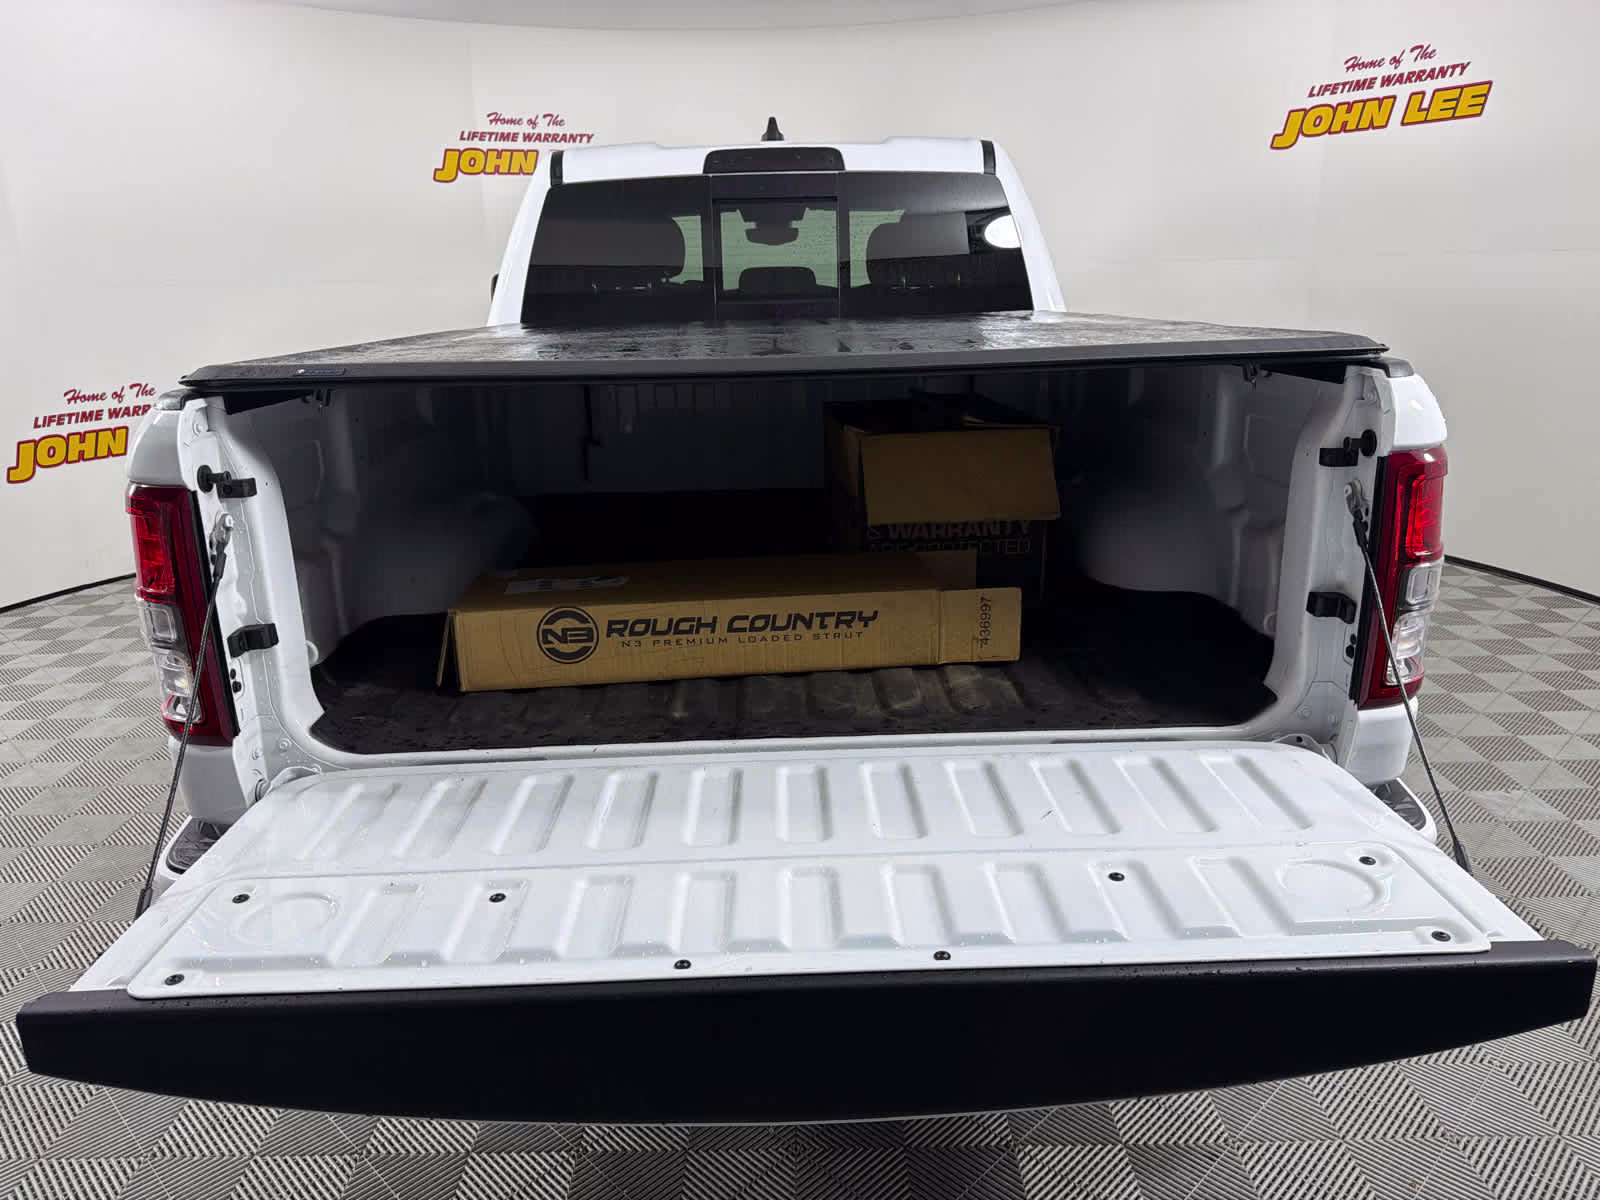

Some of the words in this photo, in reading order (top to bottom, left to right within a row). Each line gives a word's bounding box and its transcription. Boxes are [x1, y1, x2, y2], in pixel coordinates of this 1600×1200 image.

[1344, 55, 1385, 72] Home
[1389, 49, 1405, 69] of
[1409, 44, 1437, 62] The
[1308, 77, 1377, 97] LIFETIME
[1380, 61, 1471, 87] WARRANTY
[486, 112, 523, 127] Home
[527, 113, 539, 129] of
[542, 113, 566, 127] The
[1270, 95, 1397, 150] JOHN
[1400, 80, 1493, 126] LEE
[459, 130, 519, 143] LIFETIME
[522, 132, 594, 143] WARRANTY
[433, 148, 539, 183] JOHN
[64, 389, 107, 405] Home
[111, 386, 125, 404] of
[129, 383, 156, 398] The
[33, 409, 104, 429] LIFETIME
[7, 426, 129, 483] JOHN
[606, 615, 718, 638] ROUGH
[727, 610, 878, 633] COUNTRY
[979, 596, 992, 647] 436997
[621, 640, 642, 648] N3
[653, 637, 728, 647] PREMIUM
[738, 633, 802, 643] LOADED
[813, 631, 863, 641] STRUT
